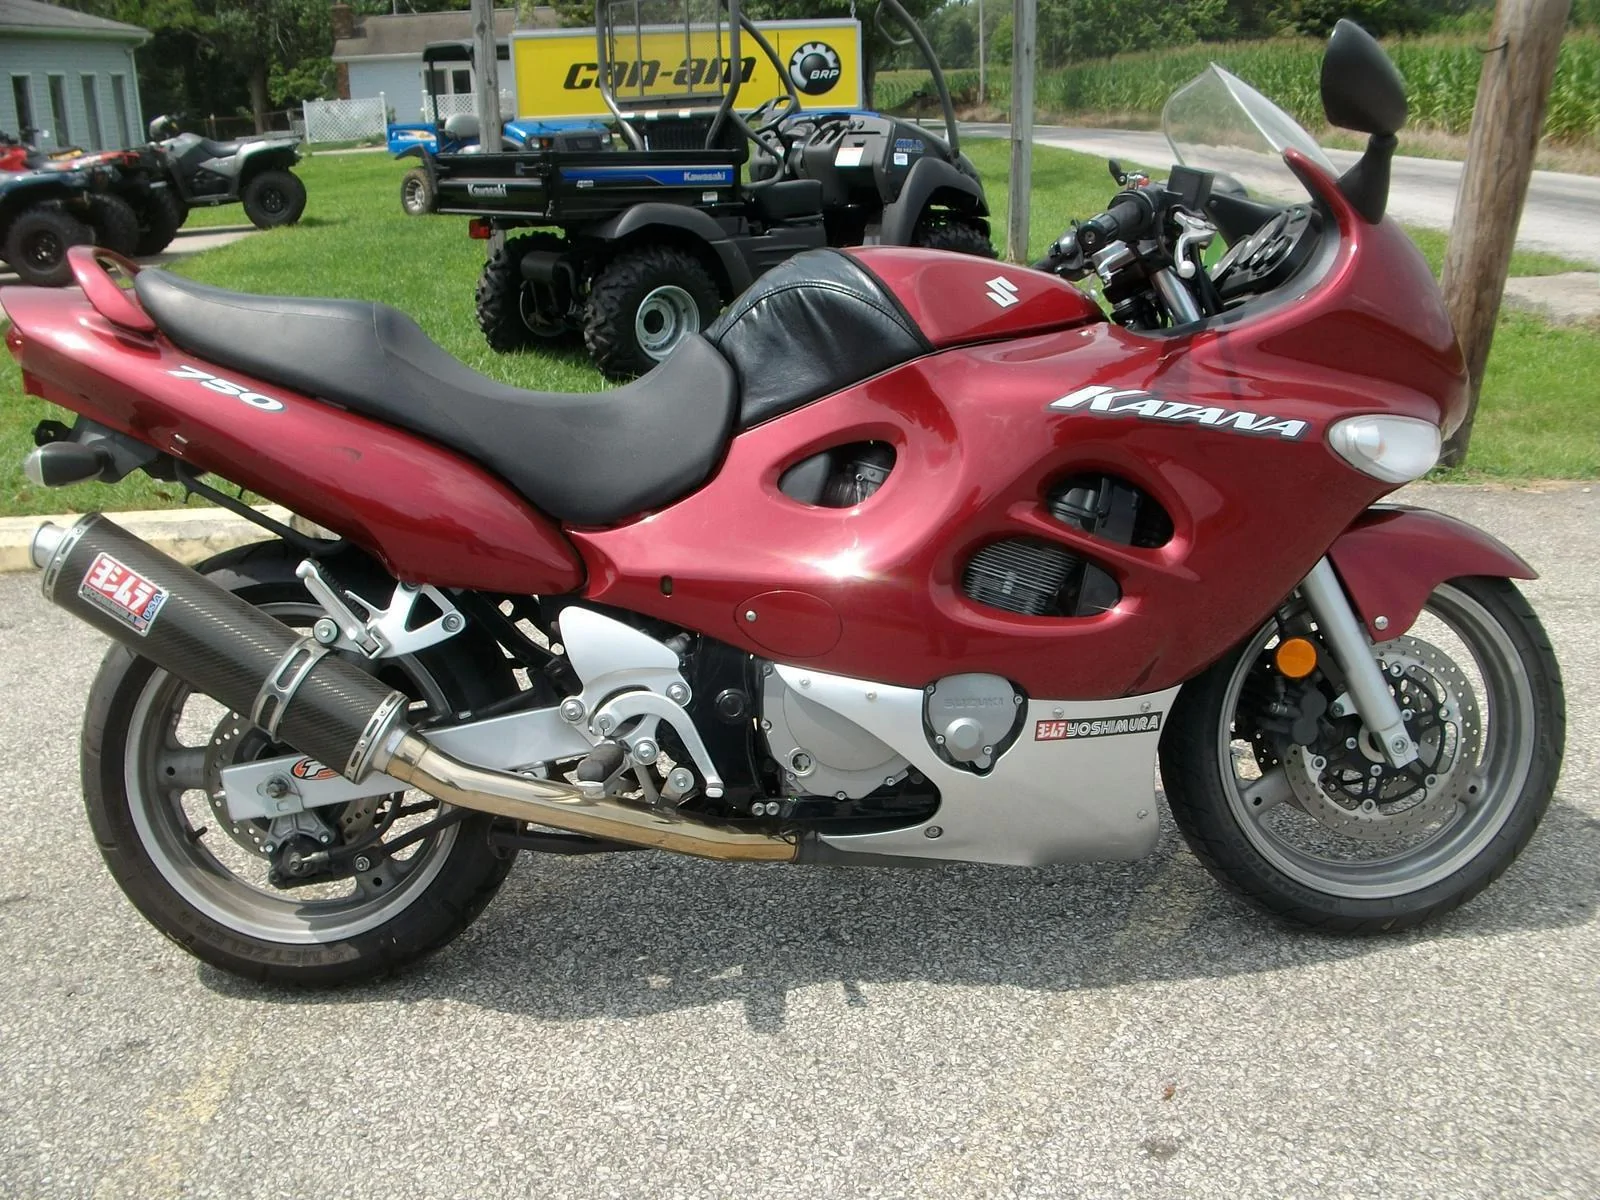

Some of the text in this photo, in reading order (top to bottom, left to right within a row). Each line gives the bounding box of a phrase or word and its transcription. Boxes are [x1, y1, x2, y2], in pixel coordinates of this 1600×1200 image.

[810, 69, 839, 80] BRP
[167, 364, 284, 411] 750
[1049, 385, 1307, 438] KATANA
[142, 592, 164, 620] USA
[943, 696, 1005, 709] SUZUKI
[1066, 714, 1160, 738] YOSHIMURA
